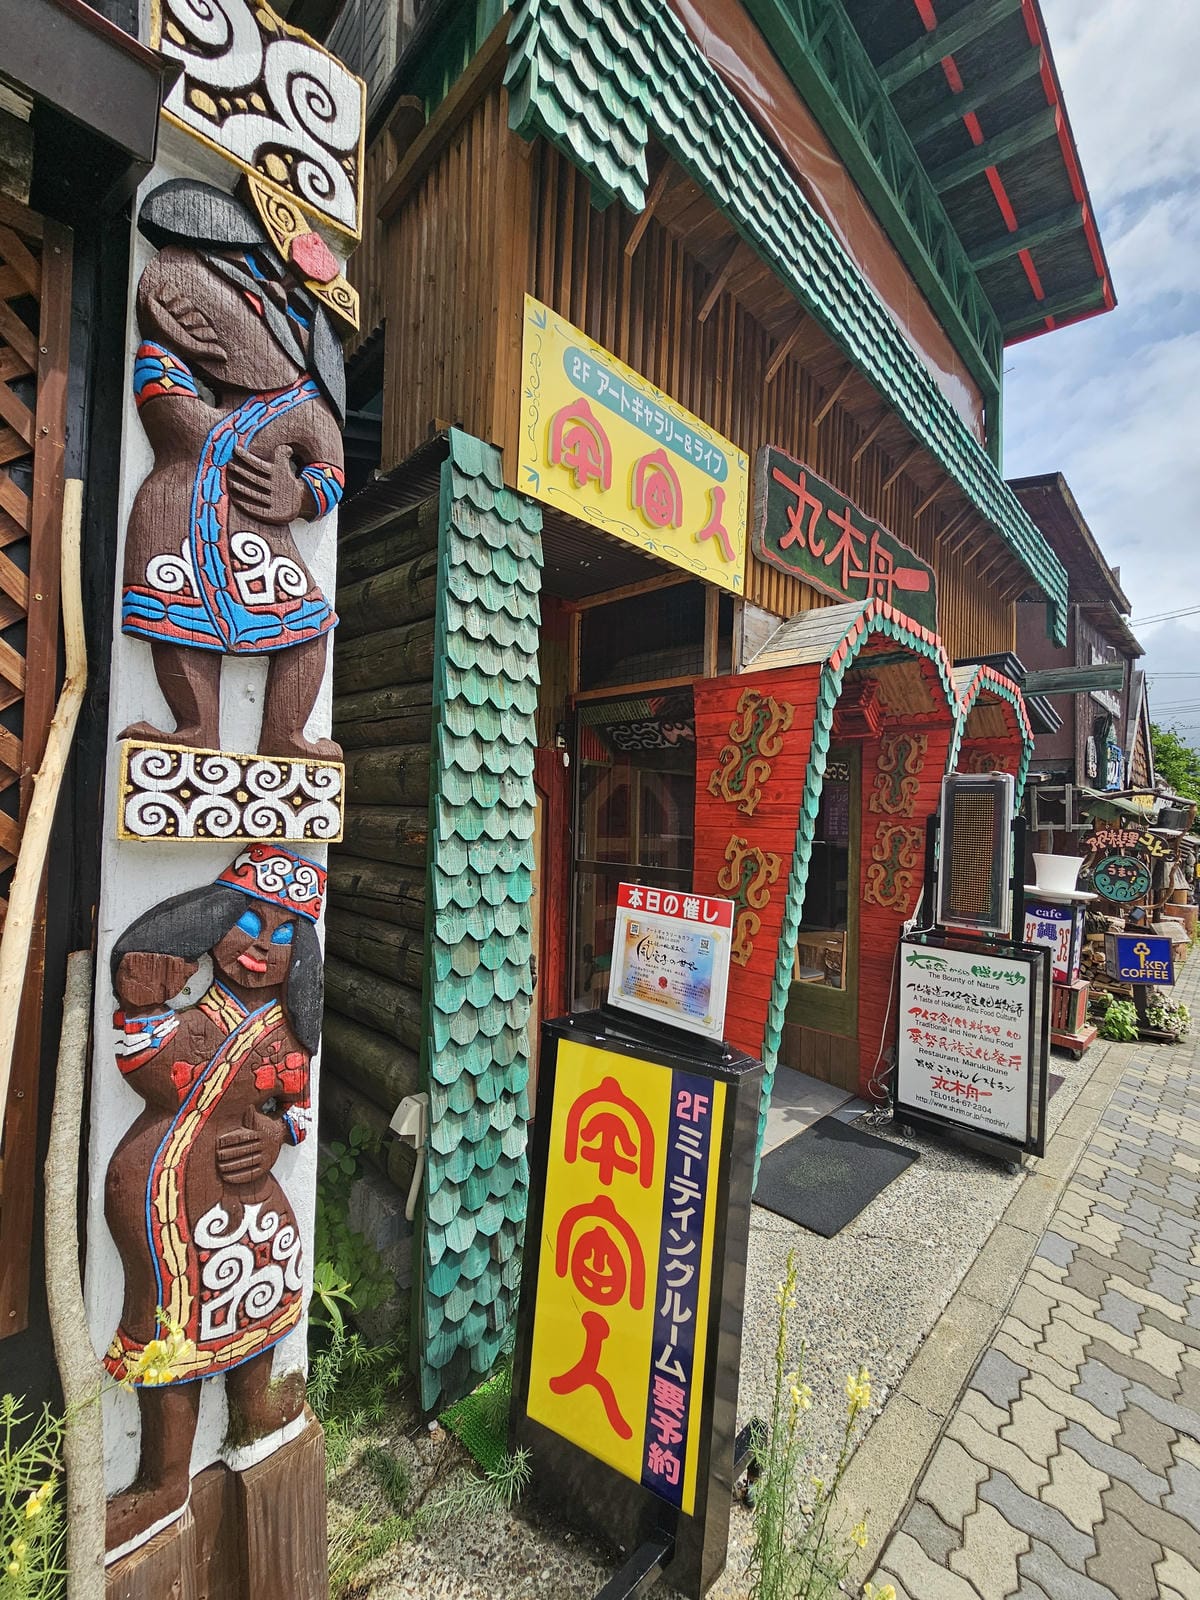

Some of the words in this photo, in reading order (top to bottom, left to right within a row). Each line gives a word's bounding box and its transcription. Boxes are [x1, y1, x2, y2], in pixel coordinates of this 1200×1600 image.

[573, 356, 590, 383] 2F
[772, 467, 930, 605] 丸木舟
[628, 888, 719, 923] 本日の催し
[1035, 907, 1062, 919] cafe
[928, 971, 941, 980] The
[943, 973, 965, 984] Bounty
[967, 978, 975, 986] of
[977, 980, 1000, 991] Nature
[1120, 968, 1169, 980] COFFEE
[919, 996, 934, 1005] Taste
[934, 998, 940, 1006] of
[941, 1000, 966, 1012] Hokkaido
[967, 1004, 979, 1014] Ainu
[980, 1007, 995, 1017] Food
[996, 1010, 1017, 1022] Culture
[915, 1019, 948, 1034] Traditional
[949, 1026, 961, 1036] and
[962, 1030, 978, 1040] New
[979, 1033, 996, 1044] Ainu
[996, 1037, 1014, 1049] Food
[918, 1047, 960, 1063] Restaurant
[962, 1058, 1009, 1076] Marukibune
[930, 1075, 993, 1102] 丸木舟
